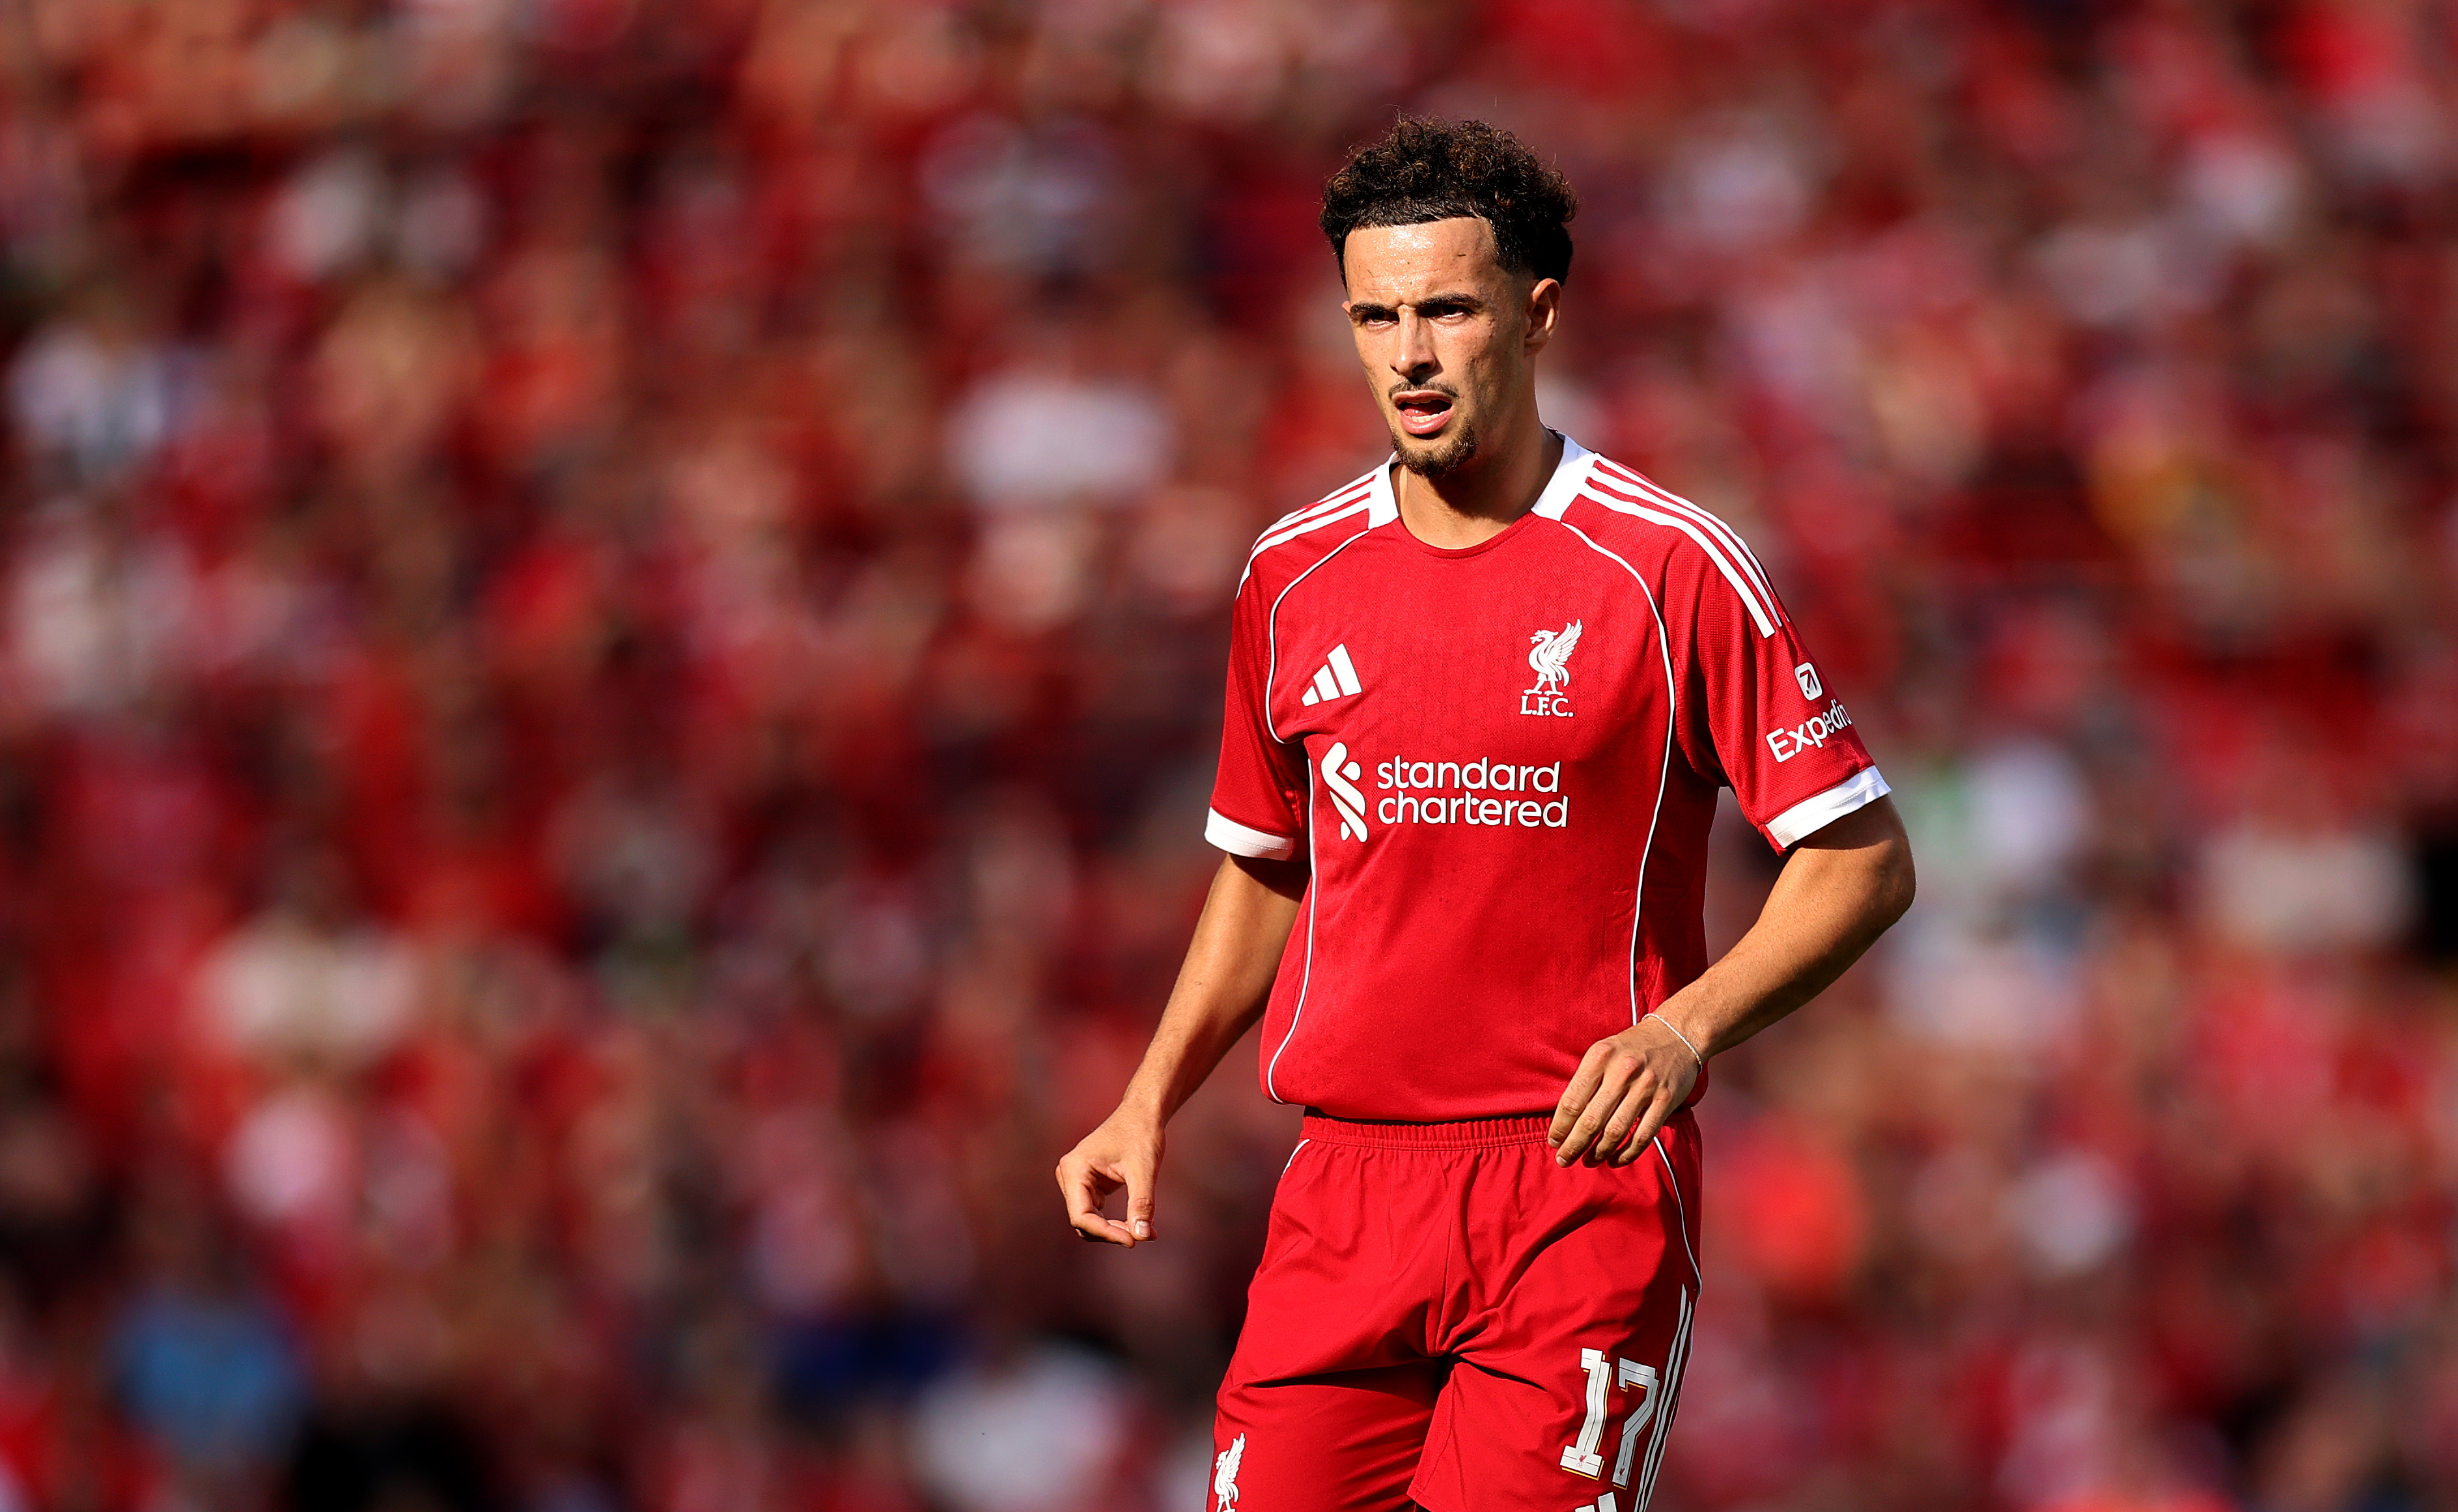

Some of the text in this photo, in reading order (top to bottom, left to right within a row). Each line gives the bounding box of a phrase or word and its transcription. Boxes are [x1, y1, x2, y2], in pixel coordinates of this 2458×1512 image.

[1520, 695, 1574, 718] L.F.C.
[1377, 755, 1560, 792] standard
[1378, 790, 1569, 828] chartered
[1560, 1347, 1660, 1489] 17
